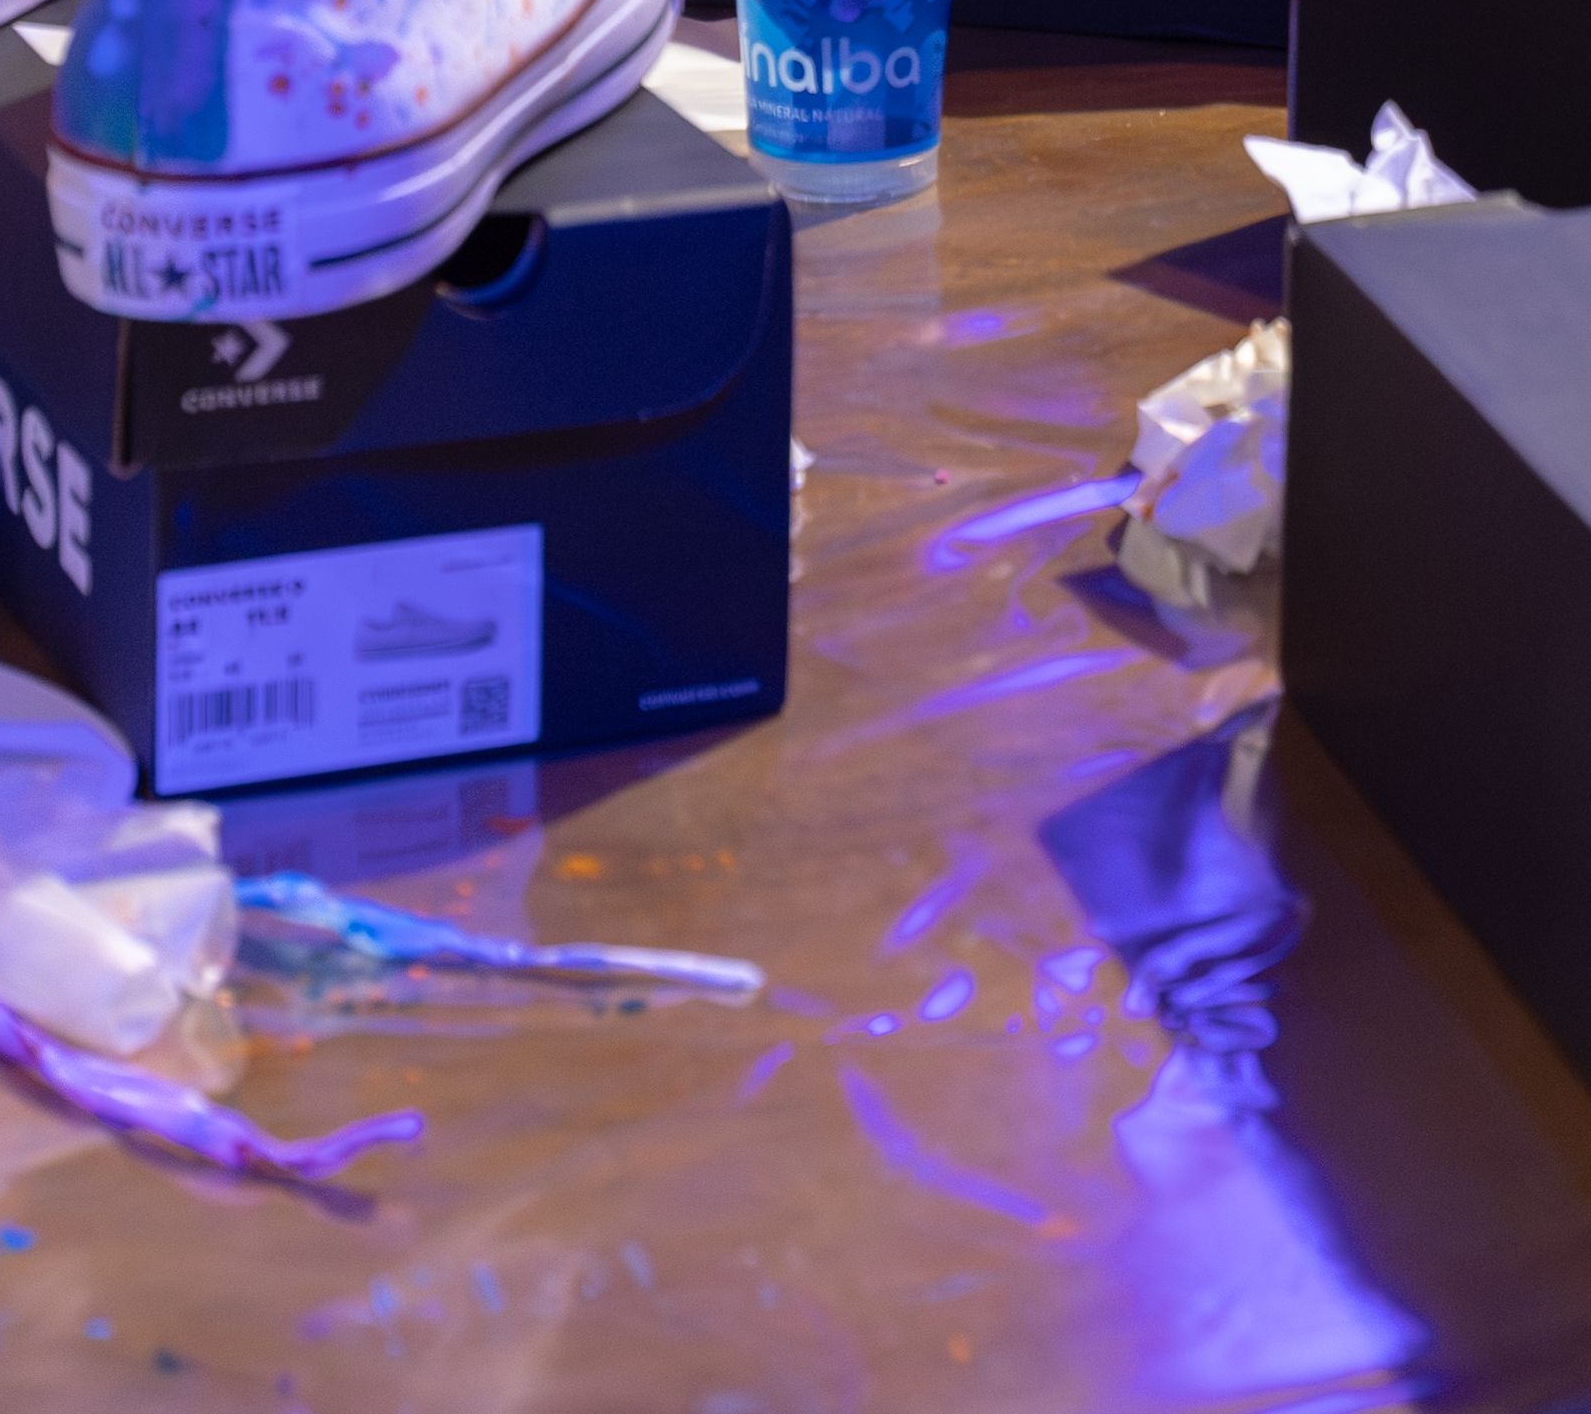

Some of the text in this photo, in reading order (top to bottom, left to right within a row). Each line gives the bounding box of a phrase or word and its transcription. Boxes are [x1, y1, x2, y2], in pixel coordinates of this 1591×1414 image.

[741, 36, 921, 94] inalba
[100, 201, 282, 241] CONVERSE
[103, 237, 286, 300] ALL STAR
